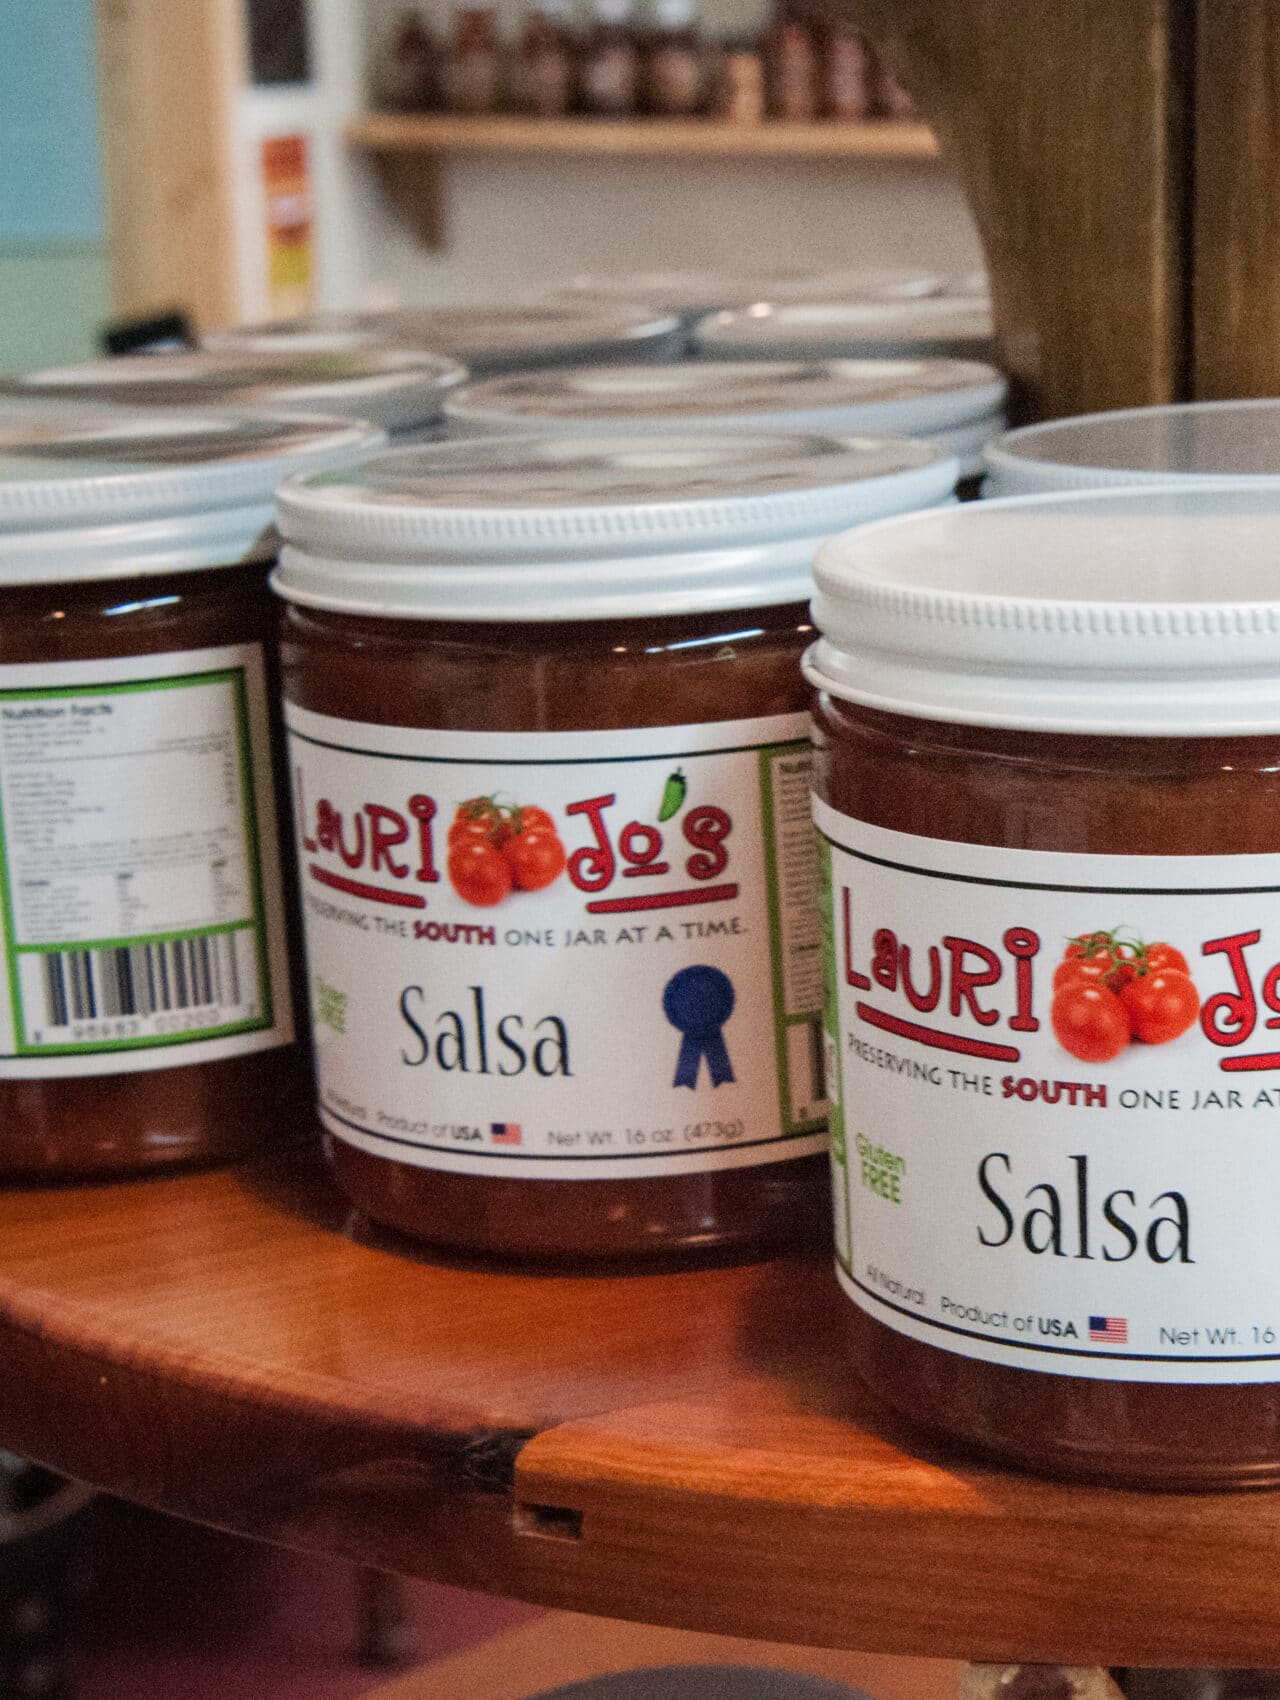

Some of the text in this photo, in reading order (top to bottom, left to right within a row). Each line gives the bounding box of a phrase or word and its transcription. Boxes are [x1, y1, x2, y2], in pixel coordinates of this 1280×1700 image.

[413, 919, 497, 946] SOUTH
[505, 929, 555, 947] ONE
[565, 928, 608, 947] JAR
[616, 926, 649, 944] AT
[656, 925, 674, 942] A
[399, 984, 575, 1078] Salsa
[847, 1031, 942, 1085] PRESERVING
[948, 1068, 993, 1096] THE
[1001, 1074, 1107, 1108] SOUTH
[1119, 1088, 1180, 1110] ONE
[1192, 1089, 1243, 1110] JAR
[451, 1124, 484, 1142] USA
[976, 1151, 1196, 1264] Salsa
[941, 1295, 1008, 1329] Product
[1013, 1315, 1034, 1332] of
[1037, 1317, 1079, 1339] USA
[1159, 1326, 1199, 1346] Net
[1253, 1325, 1276, 1344] 16
